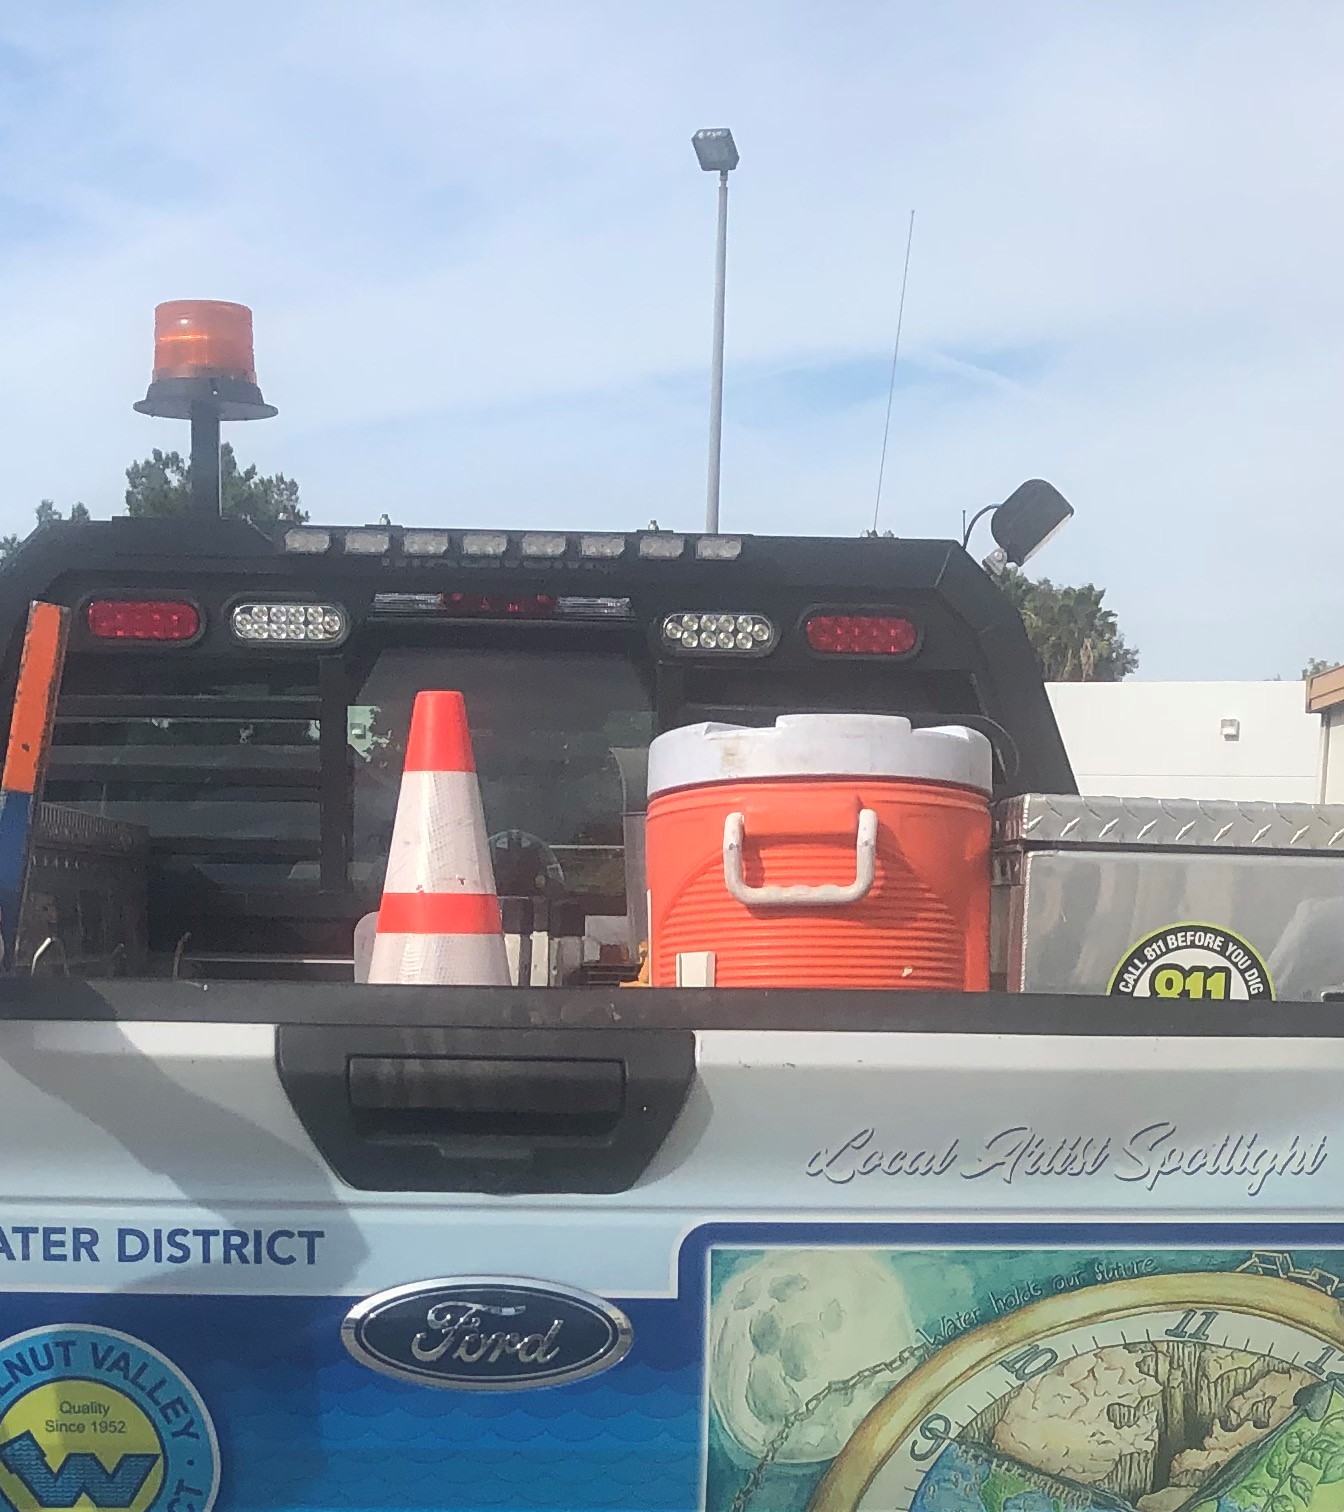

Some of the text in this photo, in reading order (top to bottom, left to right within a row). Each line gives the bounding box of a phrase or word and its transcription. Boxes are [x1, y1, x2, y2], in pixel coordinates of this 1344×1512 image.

[1118, 931, 1264, 995] CALL 811 BEFORE YOU DIG
[805, 1122, 1328, 1196] Local Artist Spotlight
[117, 1227, 325, 1265] DISTRICT
[411, 1301, 564, 1363] Ford
[916, 1307, 981, 1347] Water
[1052, 1270, 1088, 1292] our
[1165, 1309, 1219, 1340] 11
[998, 1344, 1058, 1381] 10
[59, 1400, 110, 1418] Quality
[91, 1341, 200, 1441] VALLEY
[45, 1420, 127, 1434] Since 1952
[910, 1413, 952, 1461] 9
